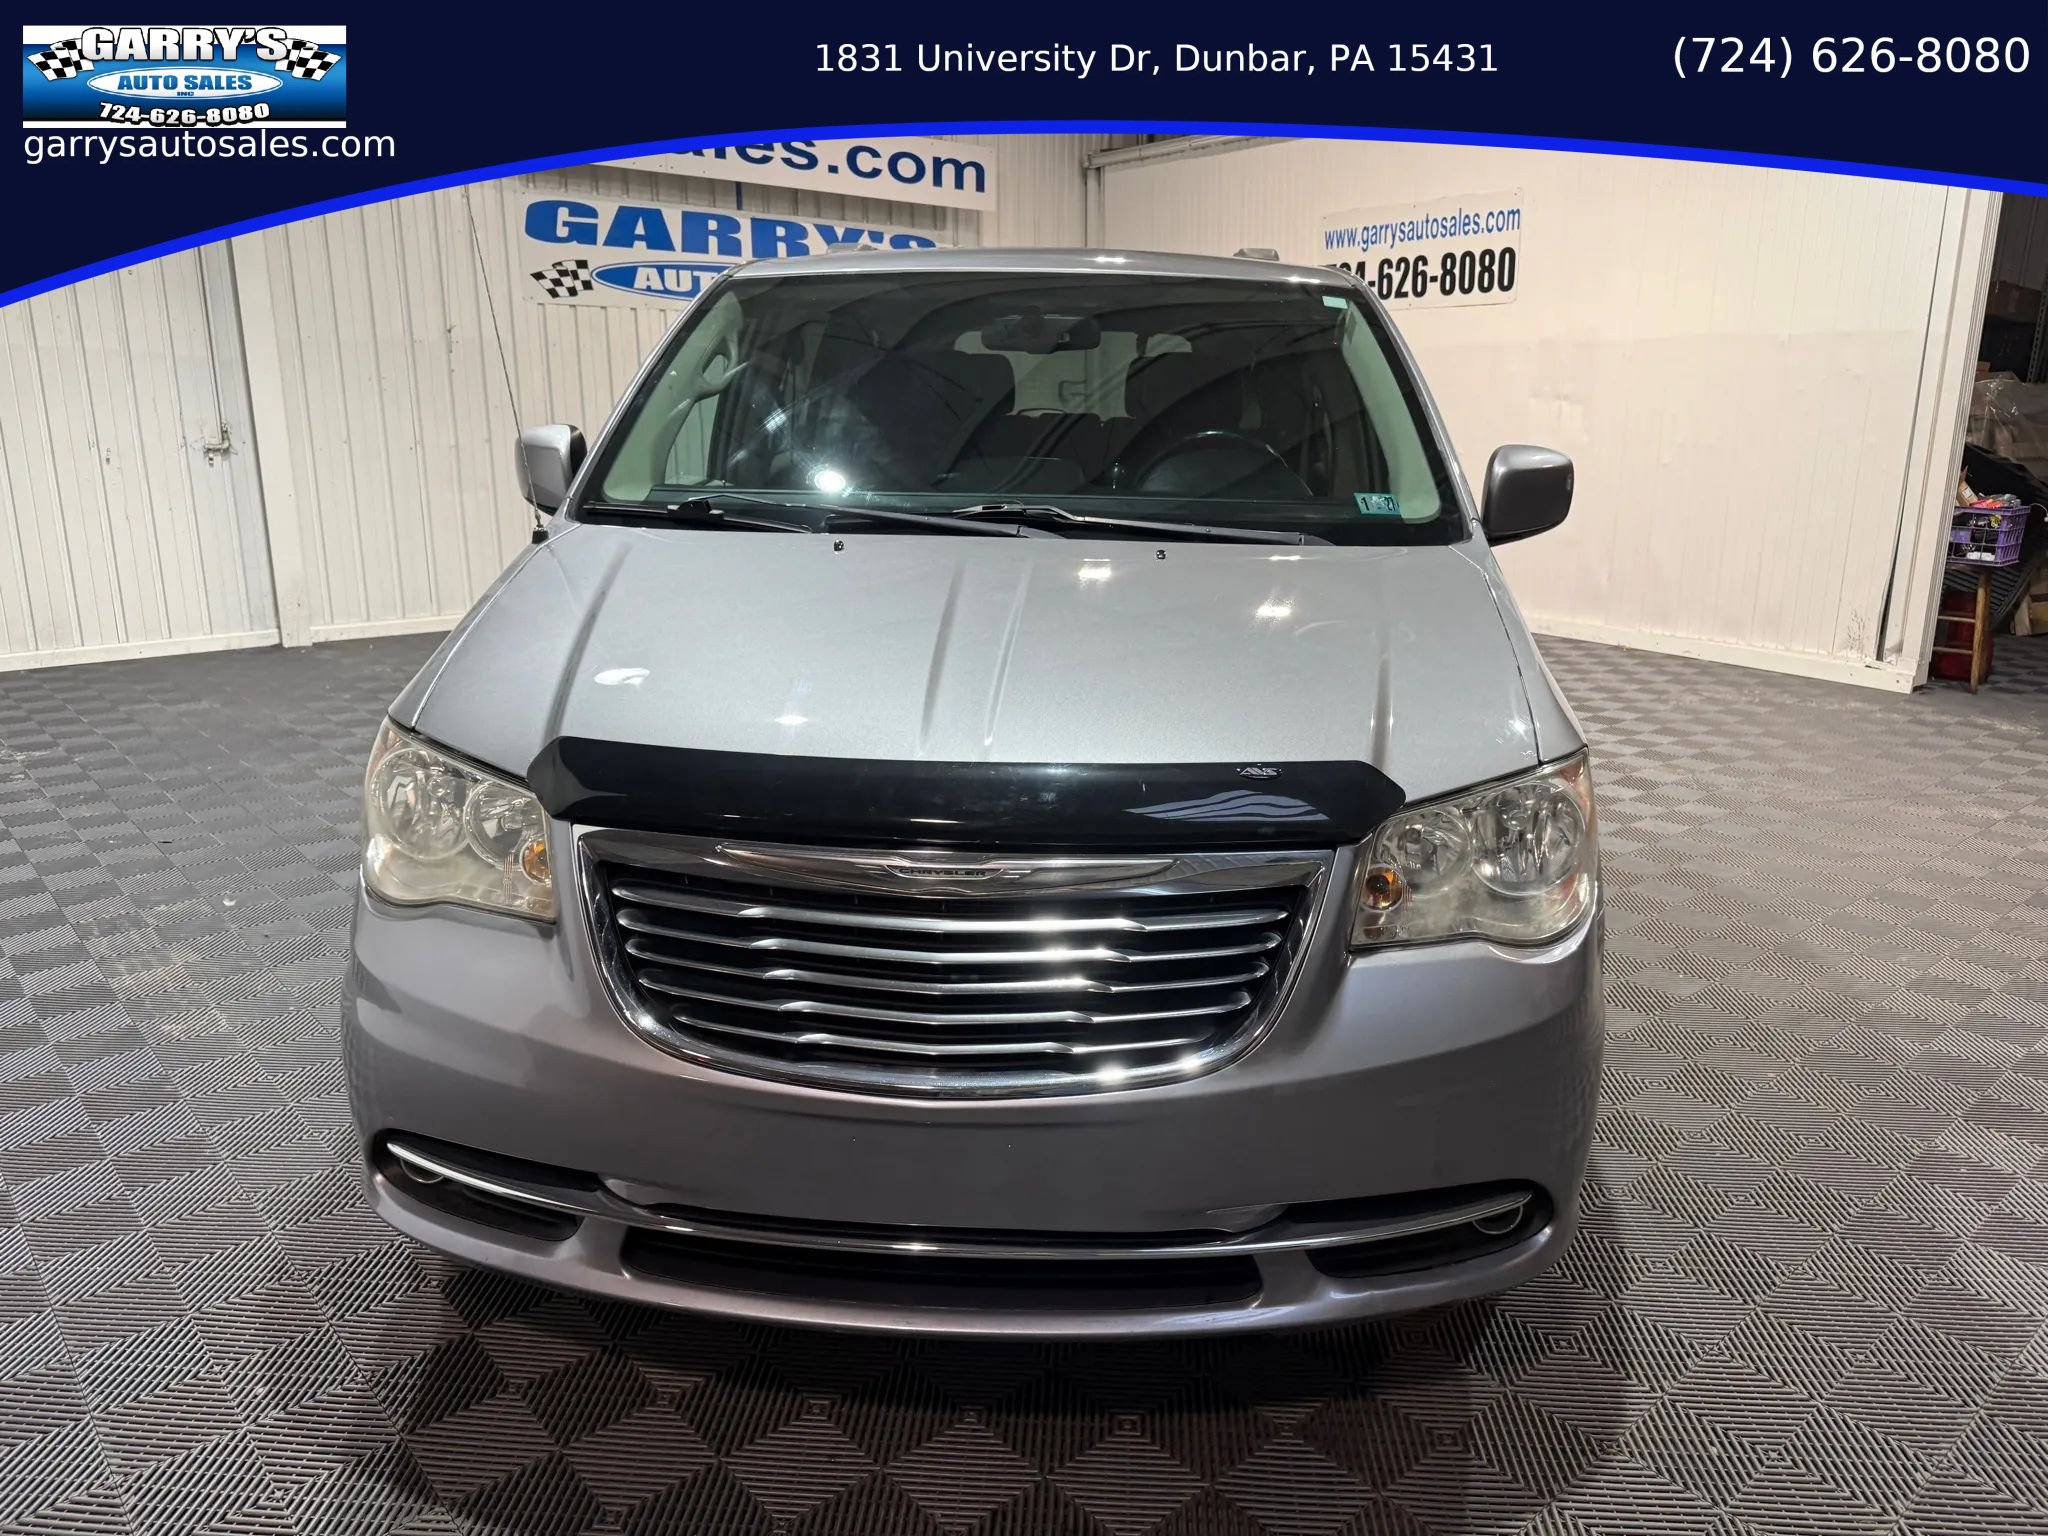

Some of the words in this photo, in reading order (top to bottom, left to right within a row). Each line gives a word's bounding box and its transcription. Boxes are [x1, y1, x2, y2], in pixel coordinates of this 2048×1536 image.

[1325, 208, 1520, 252] www.garrysautosales.com
[1325, 247, 1516, 301] -626-8080
[899, 868, 986, 877] CHRYSLER
